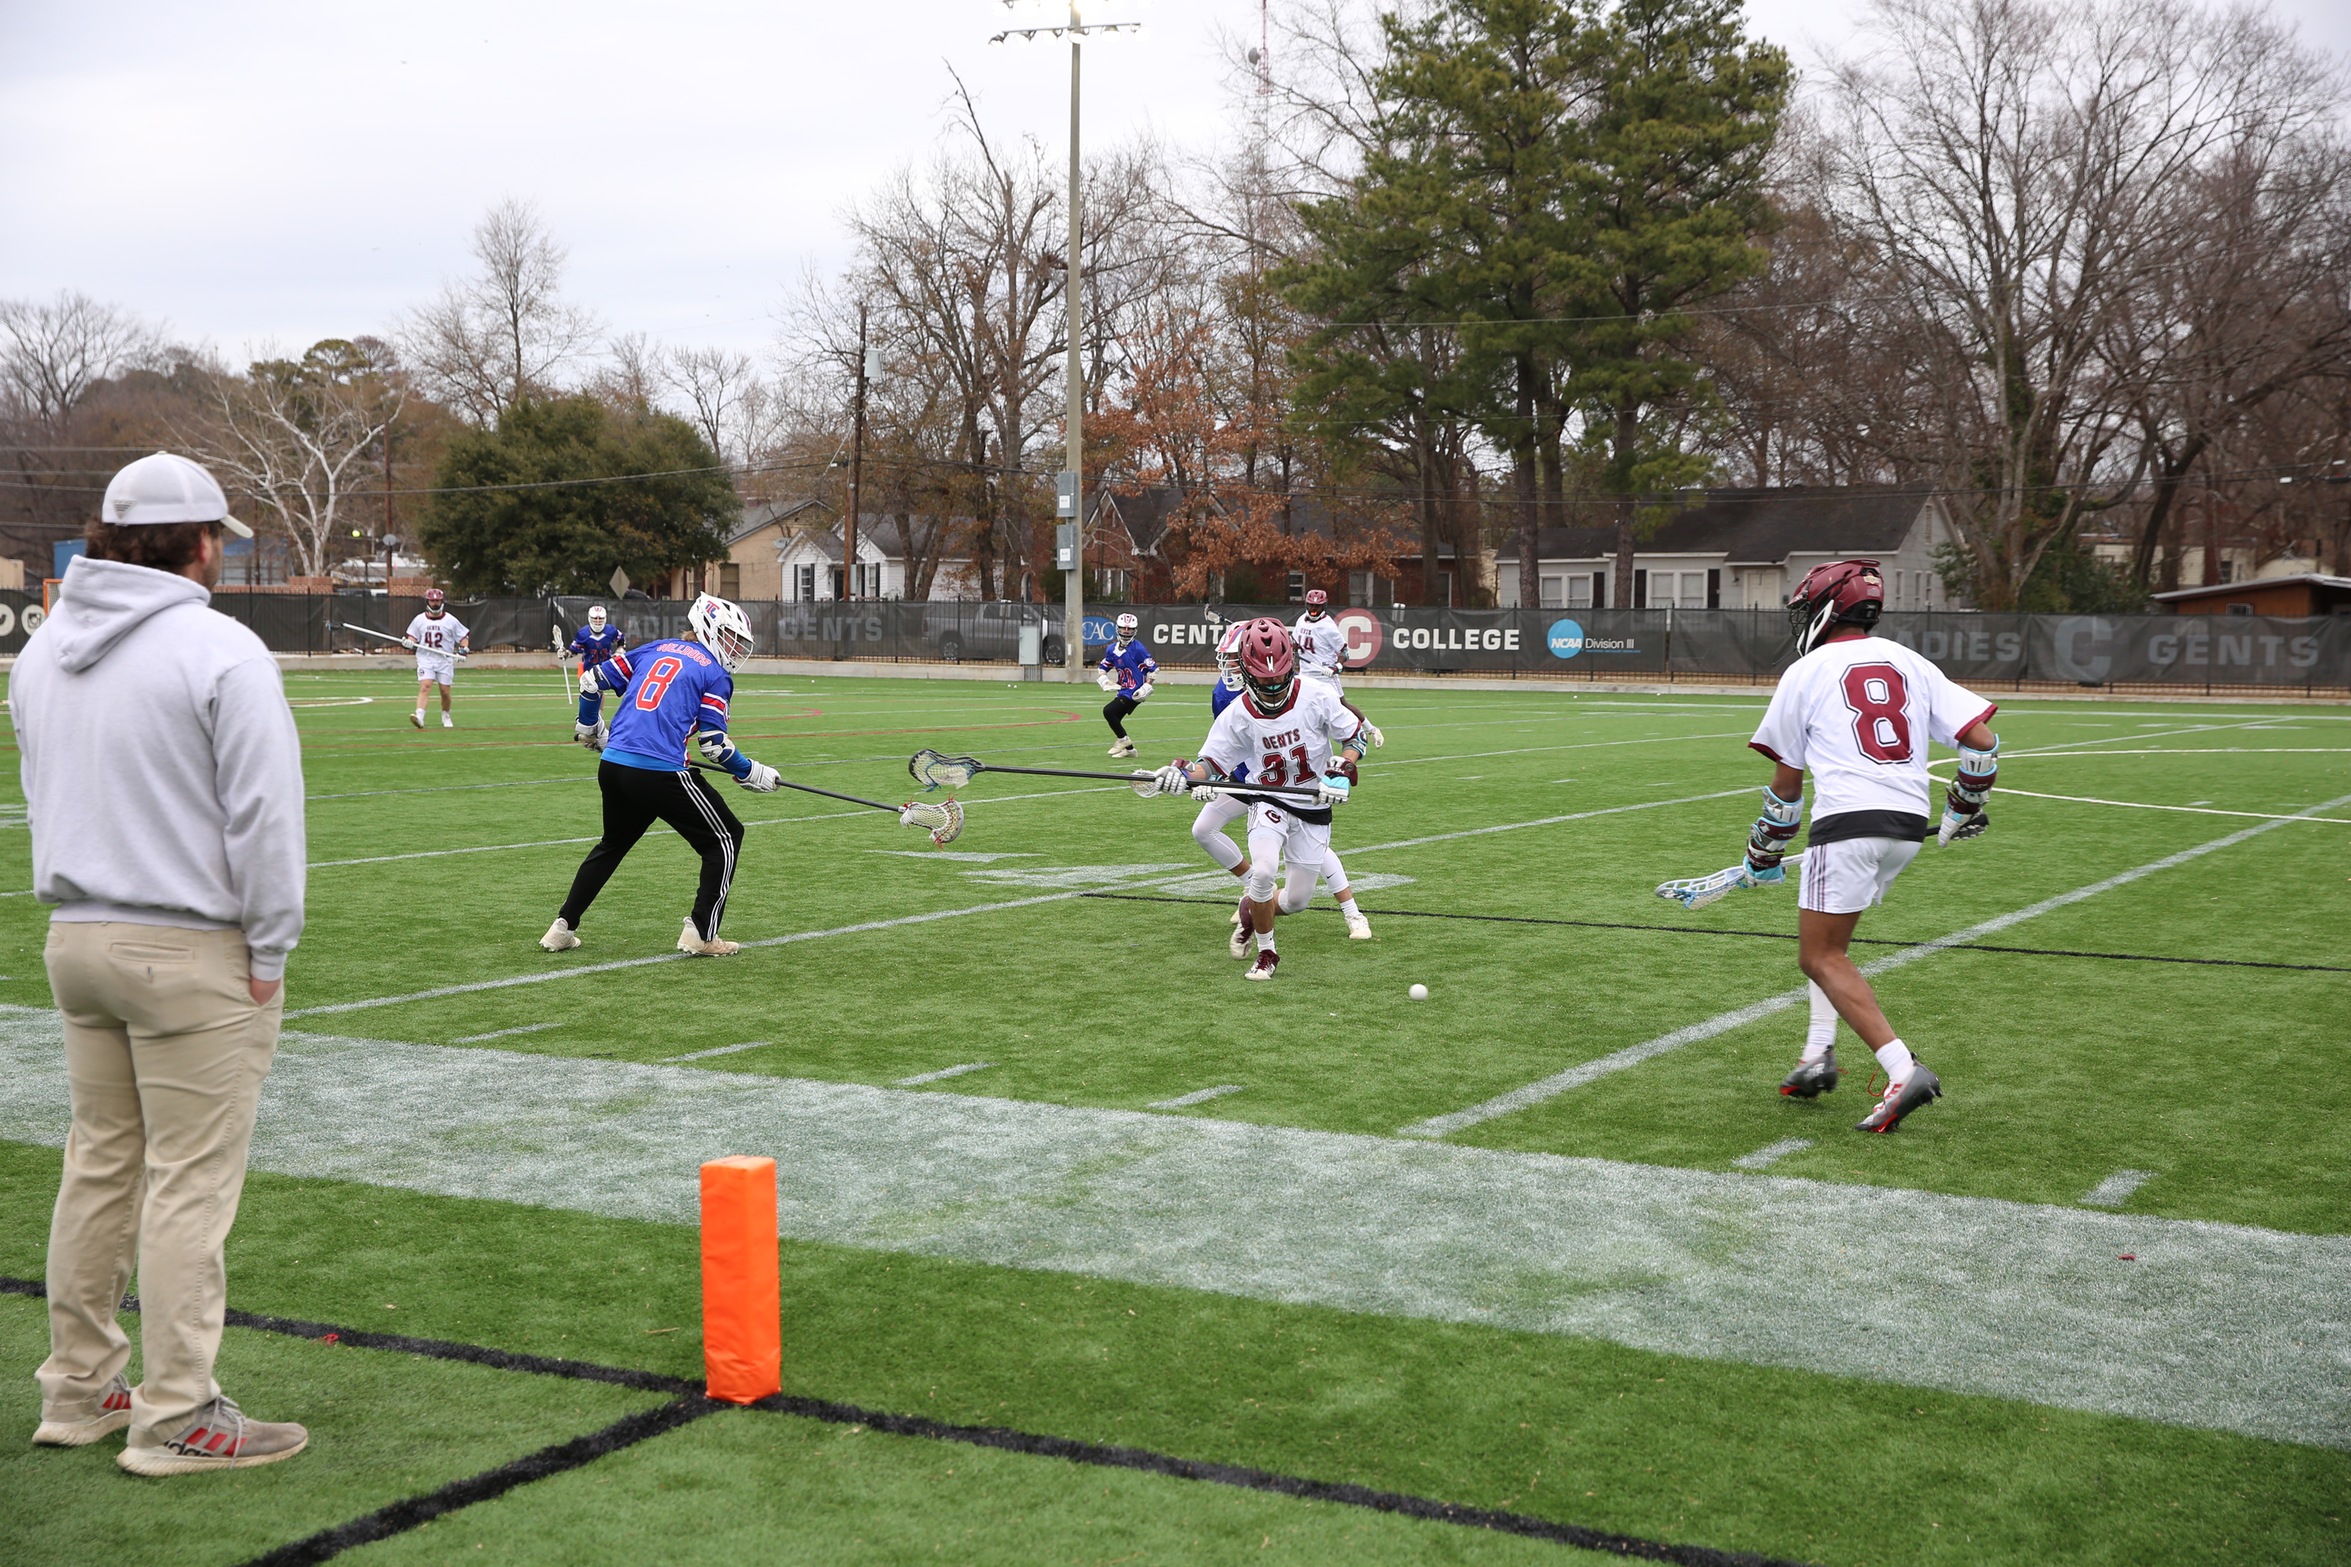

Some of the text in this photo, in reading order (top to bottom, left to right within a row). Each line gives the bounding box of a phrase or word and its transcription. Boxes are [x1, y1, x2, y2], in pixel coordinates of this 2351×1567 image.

[425, 632, 443, 648] 42
[778, 617, 883, 642] GENTS
[1393, 628, 1520, 650] COLLEGE
[1551, 638, 1582, 649] NCAA
[1585, 638, 1624, 649] Division
[1872, 631, 2021, 662] ADIES
[2147, 633, 2320, 667] GENTS
[635, 655, 683, 712] 8
[1838, 661, 1914, 765] 8
[1262, 728, 1301, 750] GENTS
[1258, 743, 1317, 788] 31
